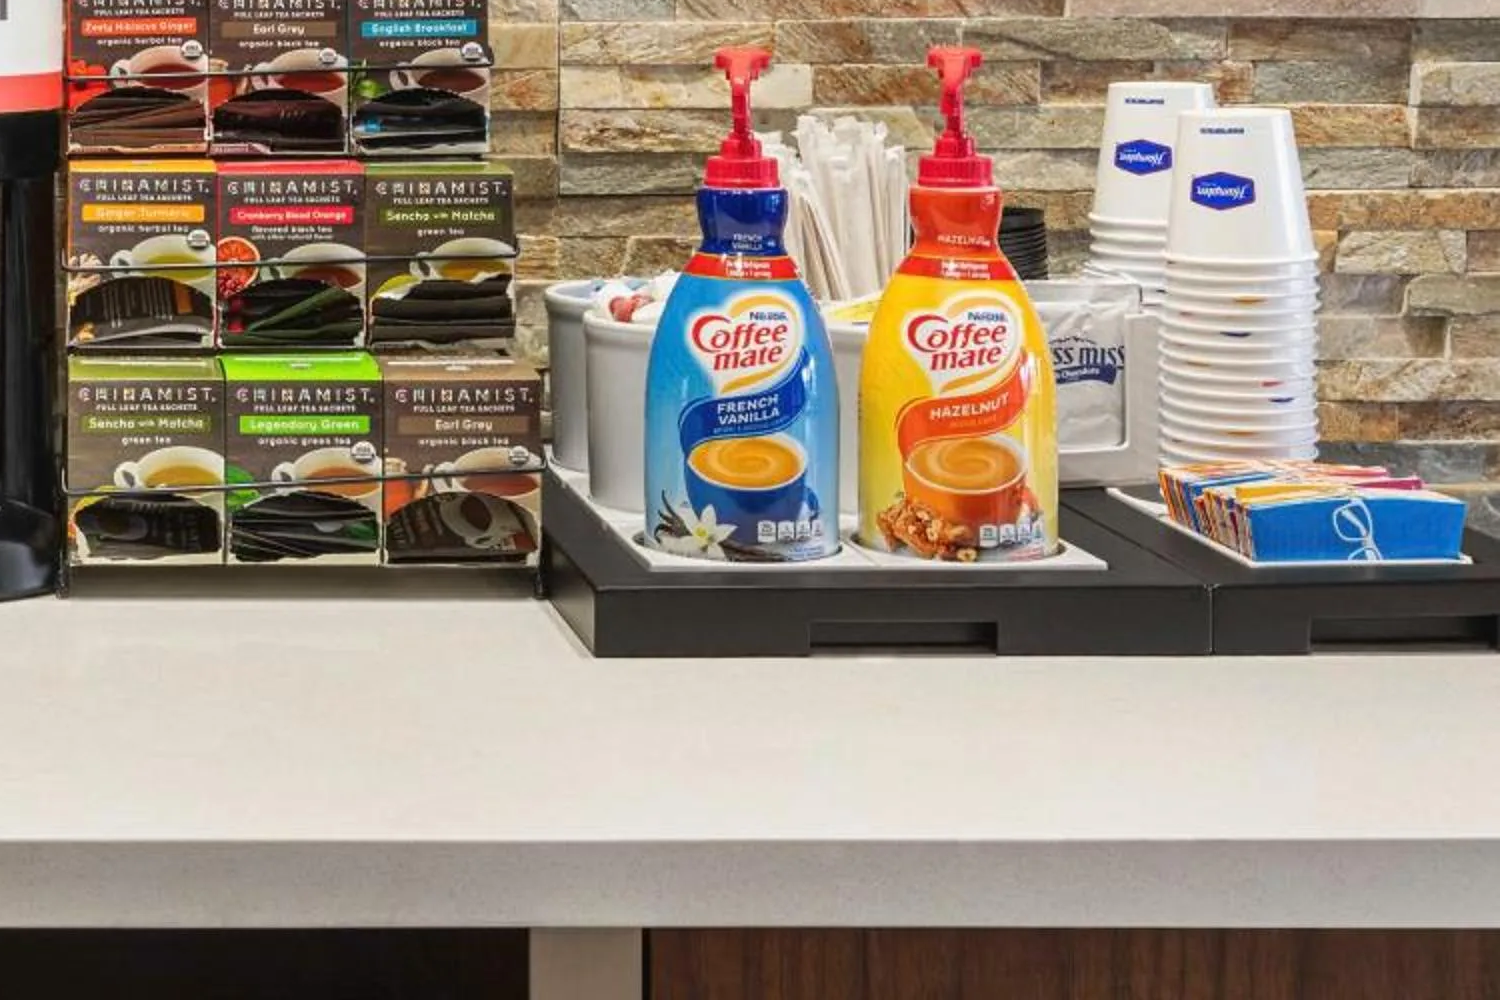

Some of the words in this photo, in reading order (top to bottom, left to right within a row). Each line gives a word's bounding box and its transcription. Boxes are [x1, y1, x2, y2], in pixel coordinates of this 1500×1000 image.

[159, 20, 193, 32] Ginger
[253, 23, 275, 35] Earl
[277, 23, 305, 36] Grey
[371, 23, 412, 34] English
[387, 210, 429, 221] Sencha
[451, 210, 495, 221] Matcha
[417, 228, 446, 237] green
[691, 314, 789, 353] Coffee
[907, 314, 1007, 353] Coffee
[712, 344, 784, 371] mate
[930, 345, 1003, 371] mate
[717, 394, 779, 414] FRENCH
[930, 392, 1009, 420] HAZELNUT
[718, 407, 780, 425] VANILLA
[89, 417, 135, 429] Sencha
[159, 418, 203, 429] Matcha
[250, 419, 318, 433] Legendary
[321, 419, 359, 430] Green
[435, 419, 459, 431] Earl
[462, 419, 493, 432] Grey
[121, 436, 152, 446] green
[257, 437, 298, 448] organic
[301, 437, 331, 446] green
